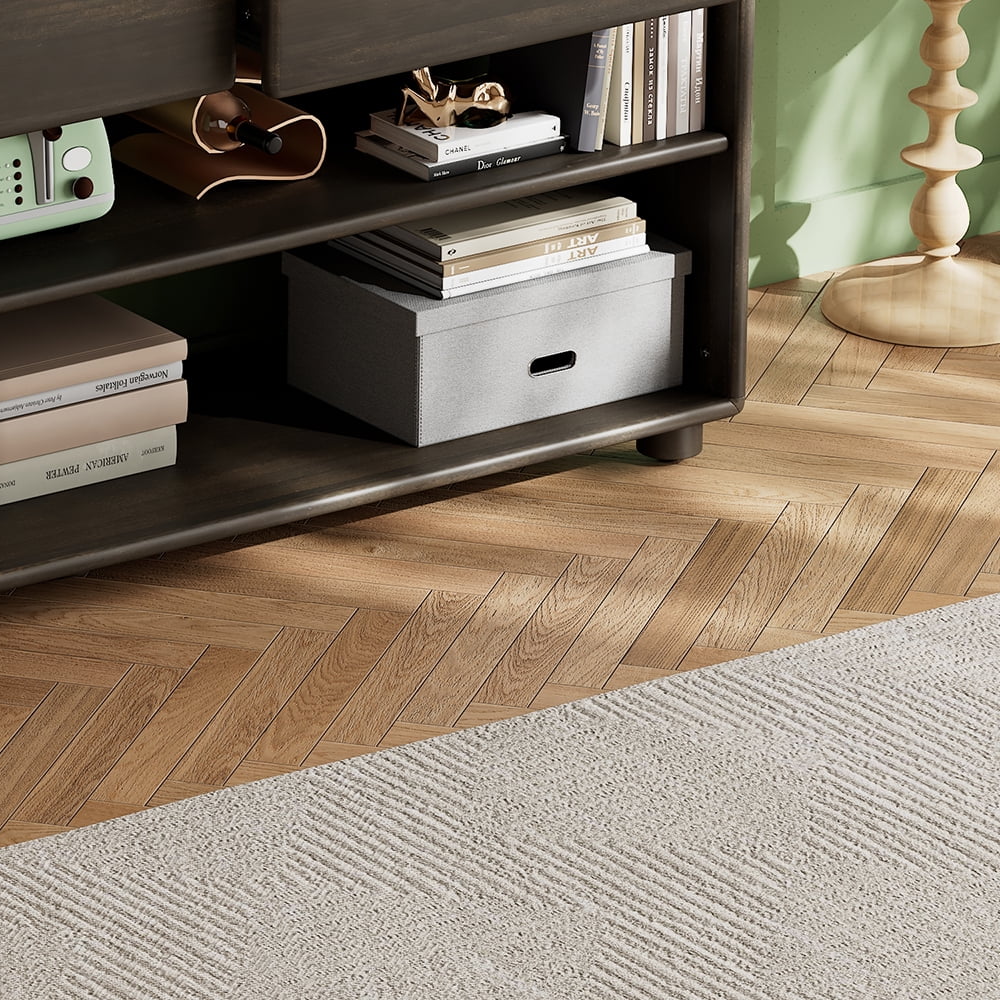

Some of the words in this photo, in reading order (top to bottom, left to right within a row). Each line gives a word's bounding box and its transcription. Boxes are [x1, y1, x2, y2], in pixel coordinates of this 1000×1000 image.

[445, 145, 472, 156] CHANEL
[477, 159, 493, 171] Dior
[496, 155, 522, 167] Glamour
[567, 232, 599, 249] ART
[567, 246, 598, 261] ART
[95, 378, 128, 392] Folktales
[129, 369, 168, 386] Norwegian
[85, 452, 130, 472] AMERICAN
[45, 464, 80, 480] PEWTER
